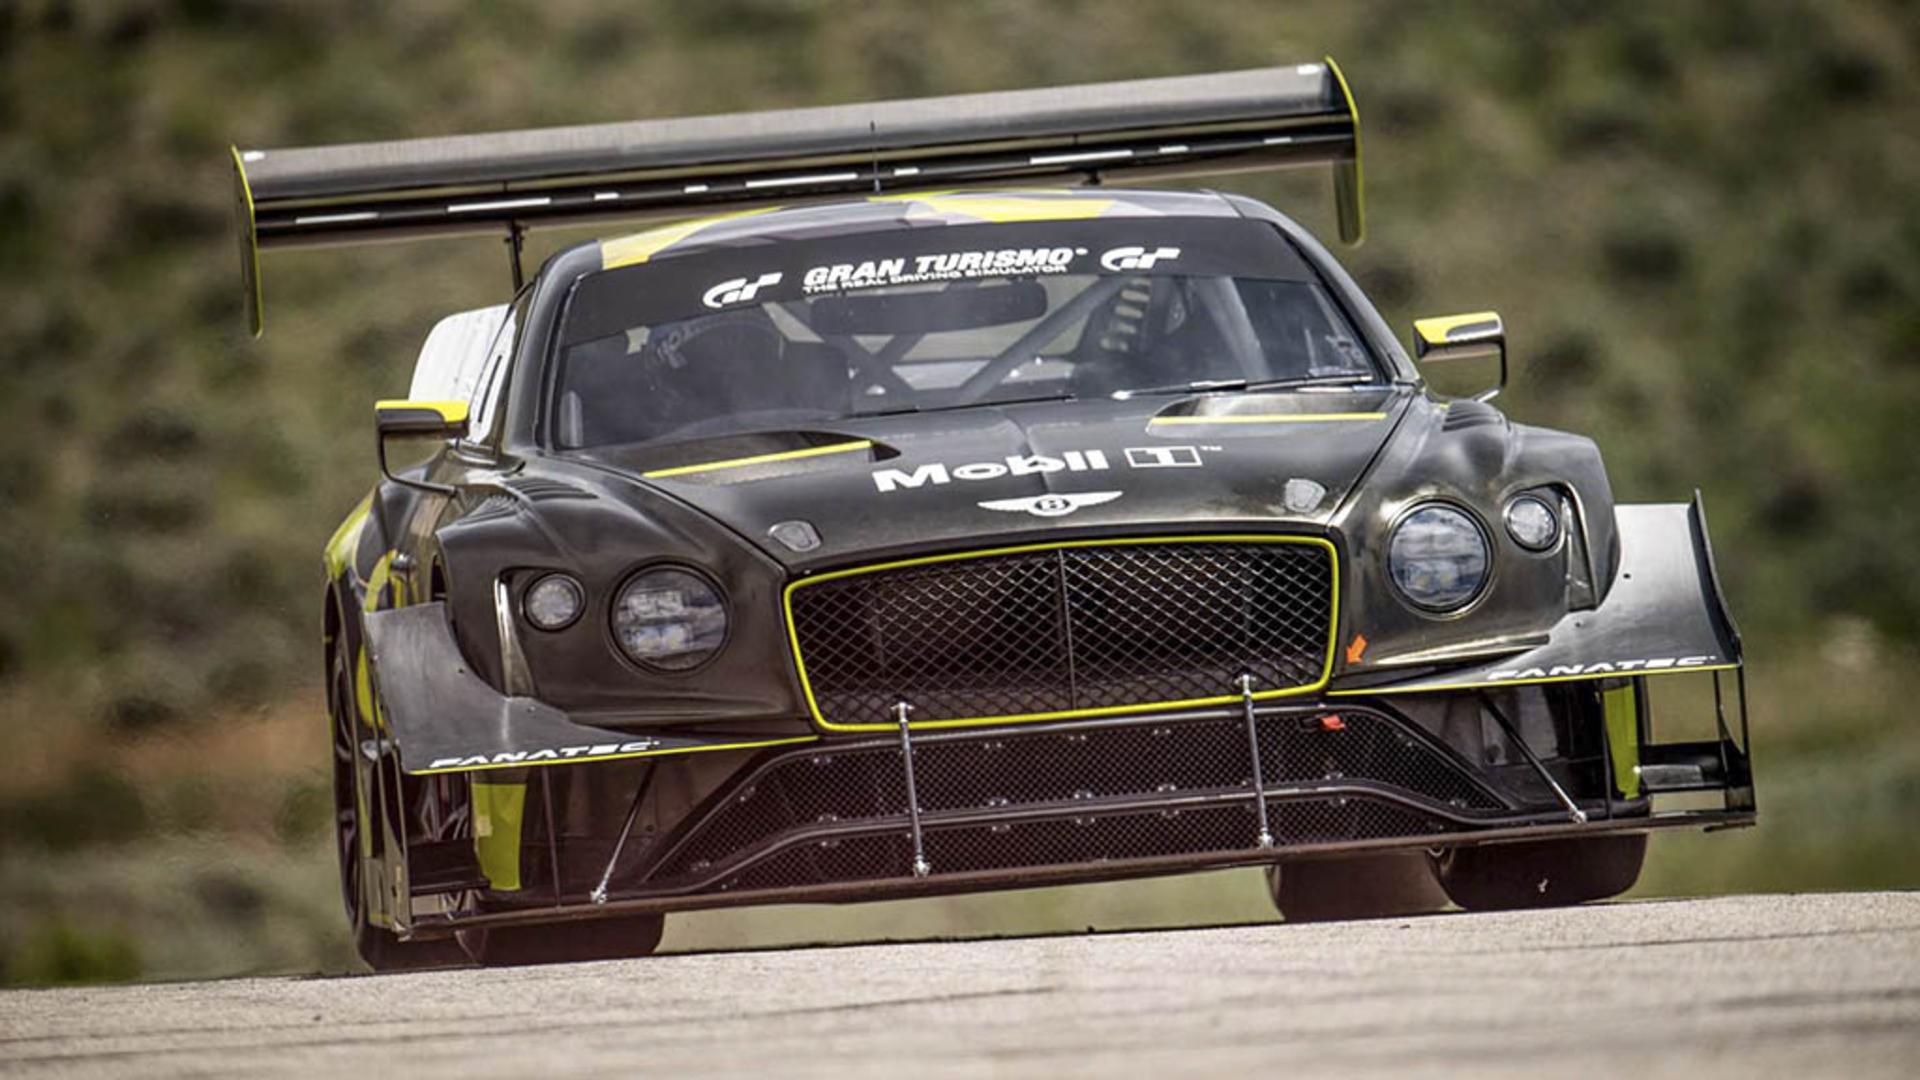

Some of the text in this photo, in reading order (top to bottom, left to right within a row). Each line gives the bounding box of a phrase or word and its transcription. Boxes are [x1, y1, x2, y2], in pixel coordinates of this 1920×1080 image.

[802, 264, 1068, 294] THE REAL DRIVING SIMULATOR
[803, 247, 1074, 286] GRAN TURISMO
[872, 450, 1109, 492] Mobil
[1487, 655, 1709, 680] FANATEC
[429, 740, 654, 768] FANATEC
